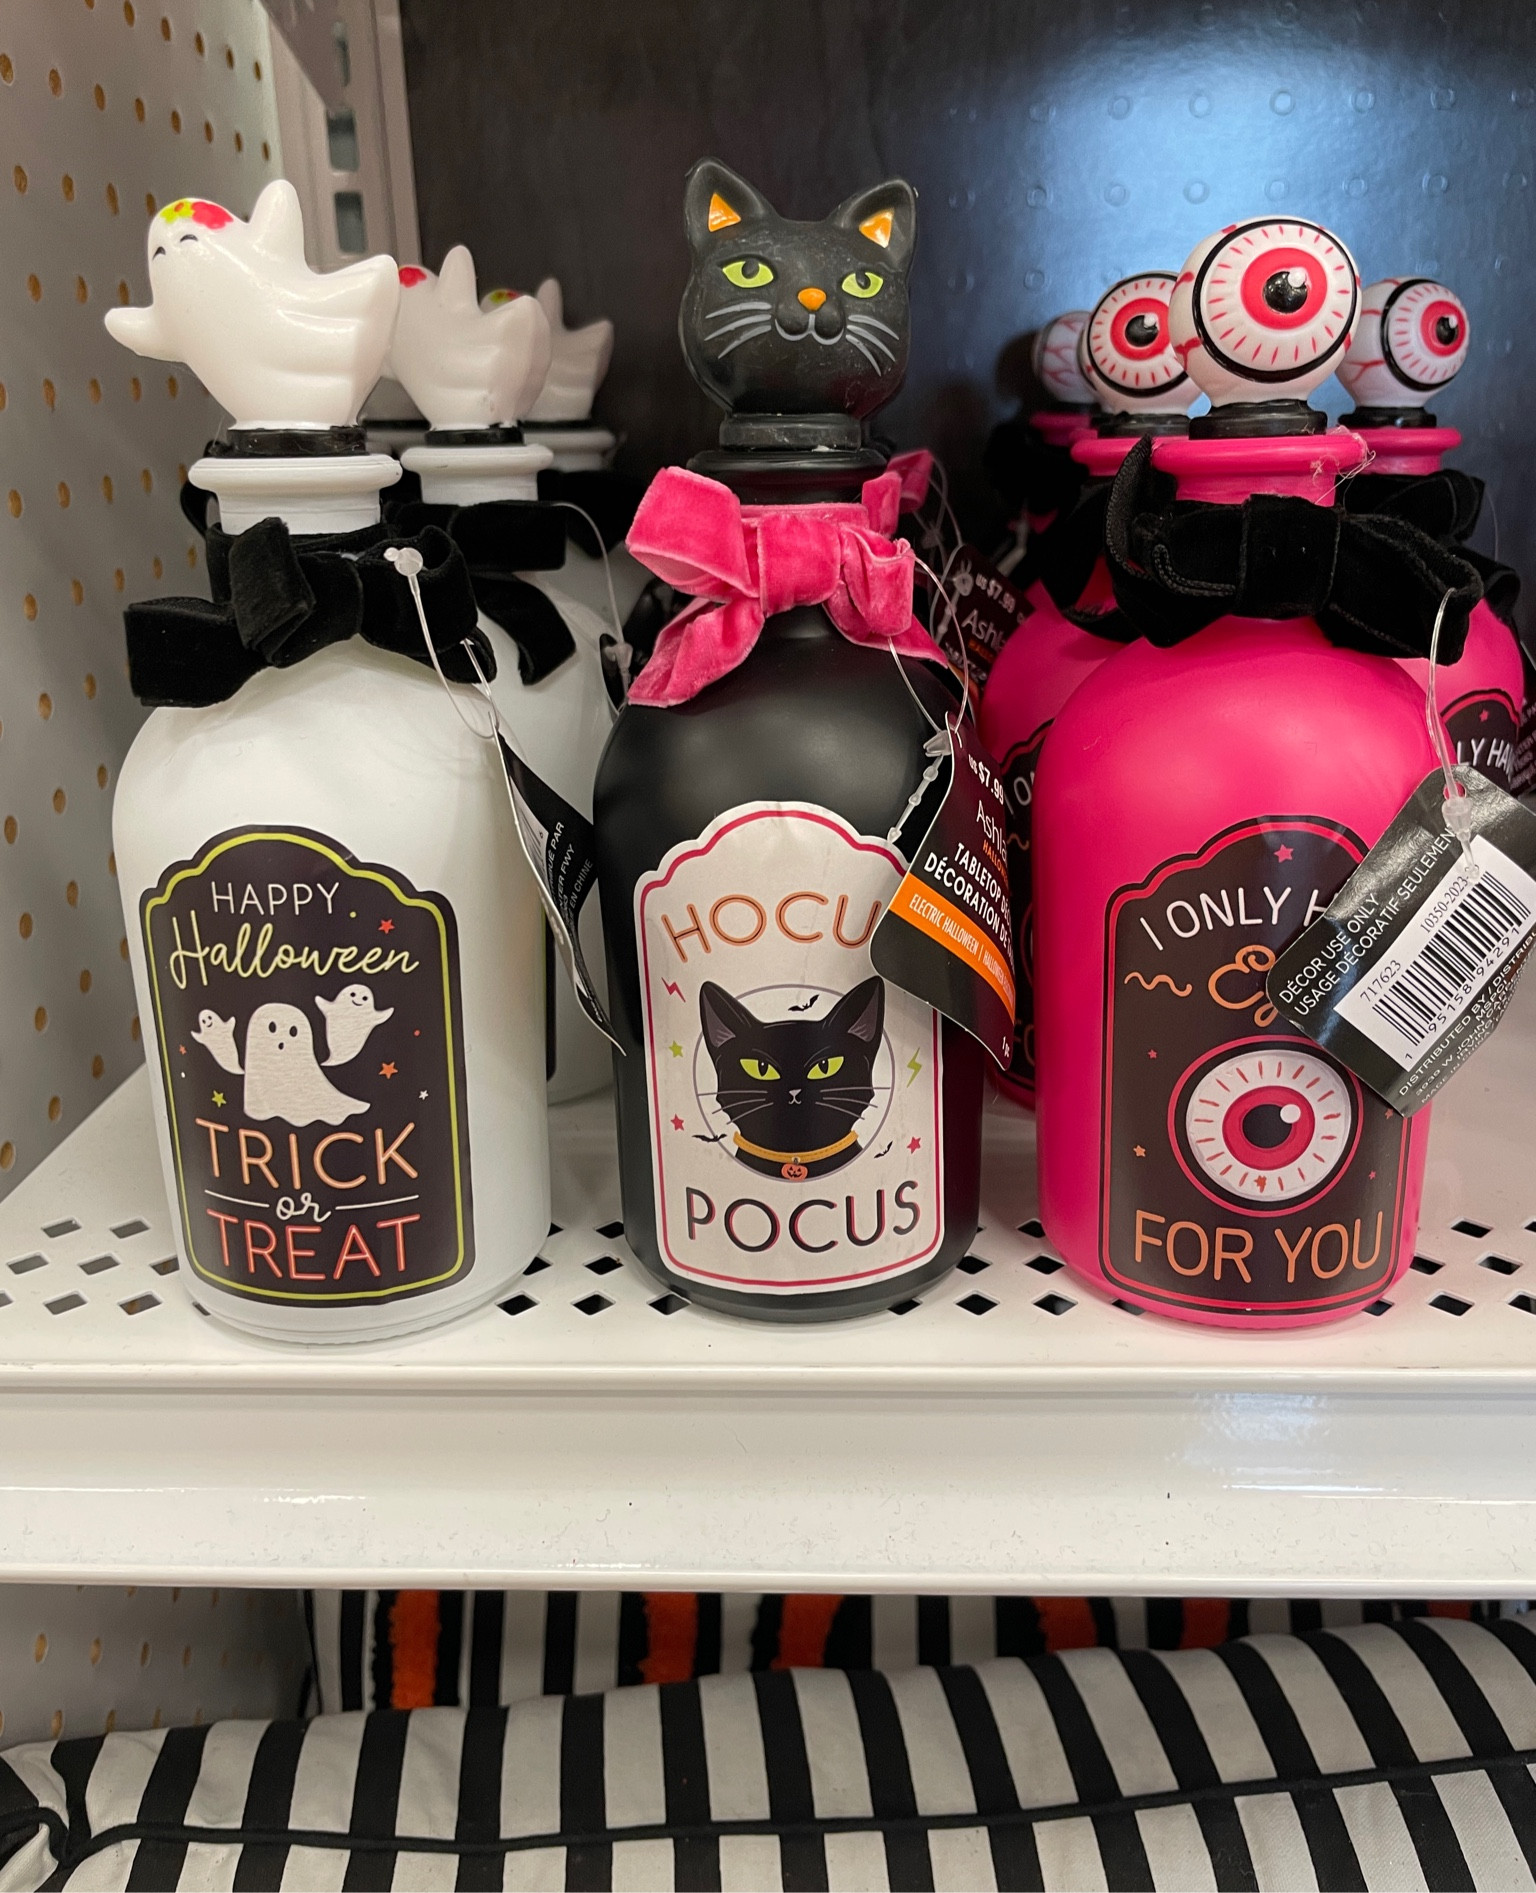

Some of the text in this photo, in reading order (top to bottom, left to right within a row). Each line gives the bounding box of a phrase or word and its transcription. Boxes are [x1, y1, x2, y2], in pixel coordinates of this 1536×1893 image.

[978, 761, 1004, 806] $7.99
[550, 821, 565, 850] PAR
[560, 843, 575, 875] FWY
[976, 799, 1007, 866] Ashla
[211, 881, 340, 916] HAPPY
[574, 858, 593, 890] CHINE
[923, 851, 1008, 949] DÉCORATION DE
[954, 842, 1002, 903] TABLETOP
[1420, 862, 1480, 934] 10350-2023-
[169, 910, 420, 989] Halloween
[661, 890, 883, 963] HOCU
[909, 893, 945, 928] ELECTRIC
[942, 916, 980, 956] HALLOWEEN
[1139, 917, 1163, 951] I
[1166, 886, 1292, 938] ONLY
[1278, 957, 1327, 1004] DÉCOR
[1320, 931, 1351, 961] USE
[1346, 893, 1380, 934] ONLY
[1294, 970, 1341, 1017] USAGE
[1335, 898, 1401, 974] DÉCORATIF
[1397, 824, 1458, 901] SEULEMEN
[1359, 958, 1402, 1003] 717623
[1428, 984, 1473, 1033] 95158
[1476, 927, 1521, 977] 94291
[1476, 979, 1508, 1022] MSPCI
[1399, 1014, 1472, 1096] DISTRIBUTED
[1471, 993, 1487, 1015] BY
[1441, 1054, 1454, 1068] W
[1456, 1019, 1486, 1055] JOHN
[196, 1117, 419, 1190] TRICK
[276, 1192, 332, 1222] or
[686, 1180, 921, 1253] POCUS
[206, 1208, 421, 1281] TREAT
[1134, 1209, 1384, 1283] FOR YOU
